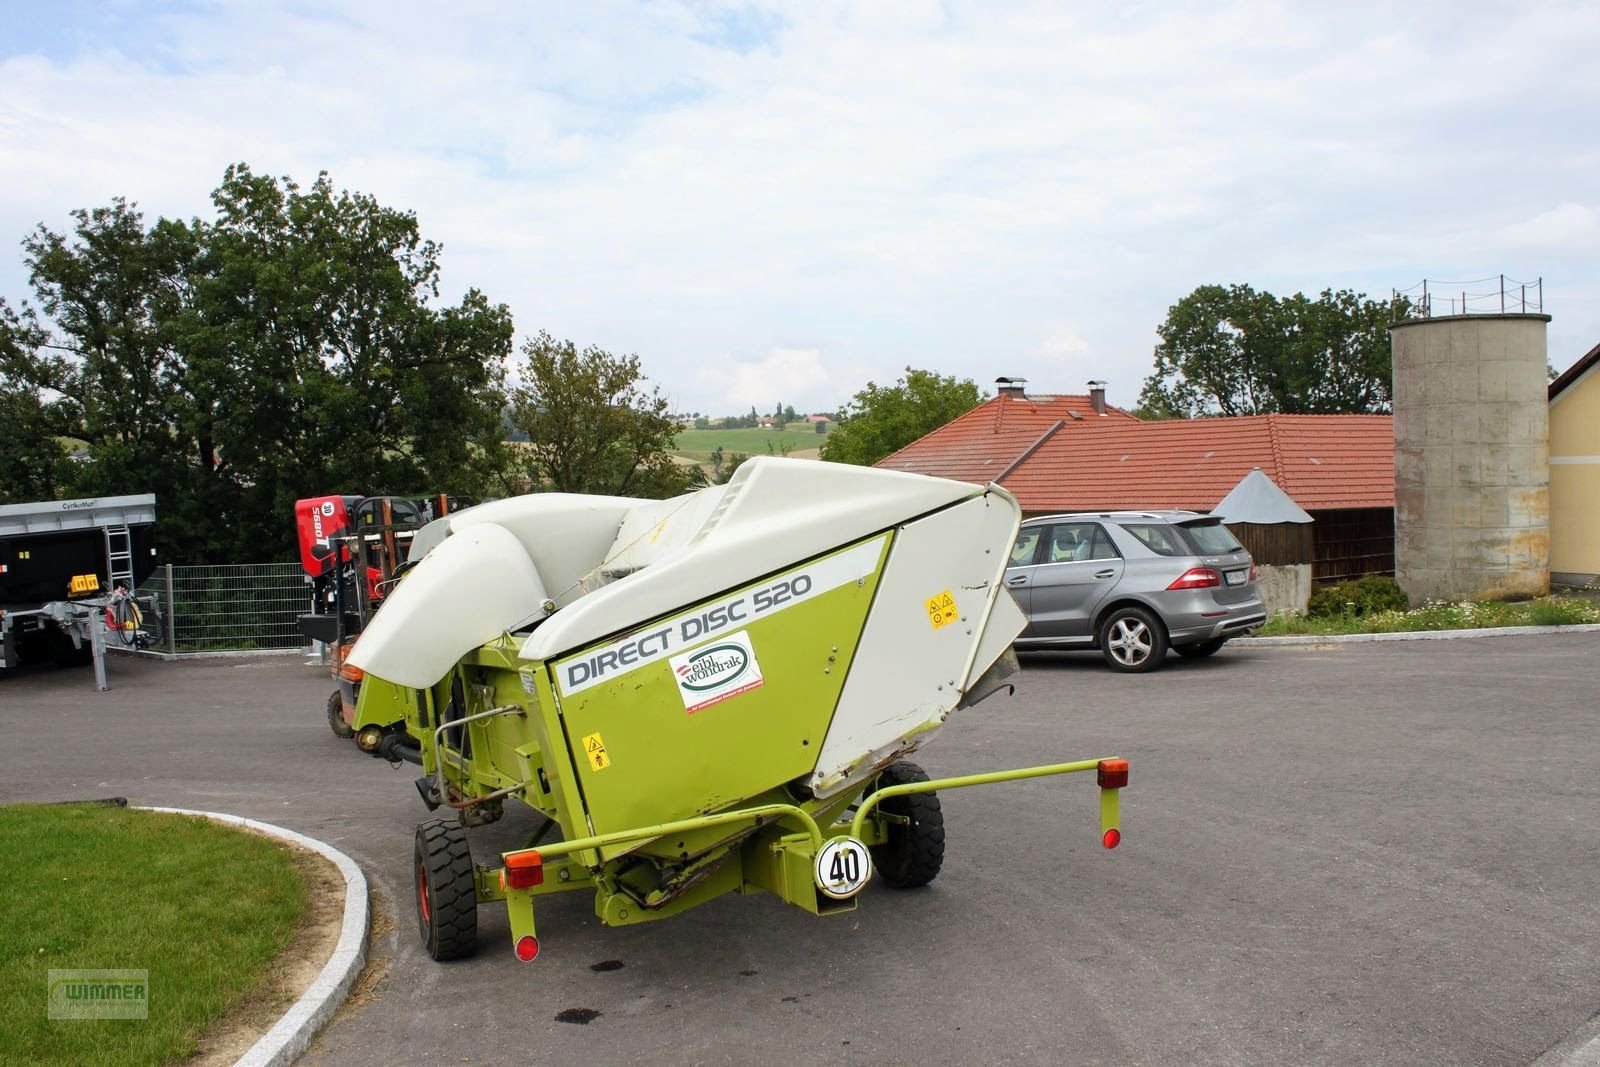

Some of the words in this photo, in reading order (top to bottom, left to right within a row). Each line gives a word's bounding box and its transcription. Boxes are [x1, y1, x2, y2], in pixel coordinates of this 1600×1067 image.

[567, 628, 673, 688] DIRECT
[681, 599, 747, 642] DISC
[753, 574, 812, 613] 520
[686, 656, 742, 683] wondrak
[692, 656, 715, 673] eibl
[830, 848, 860, 882] 40
